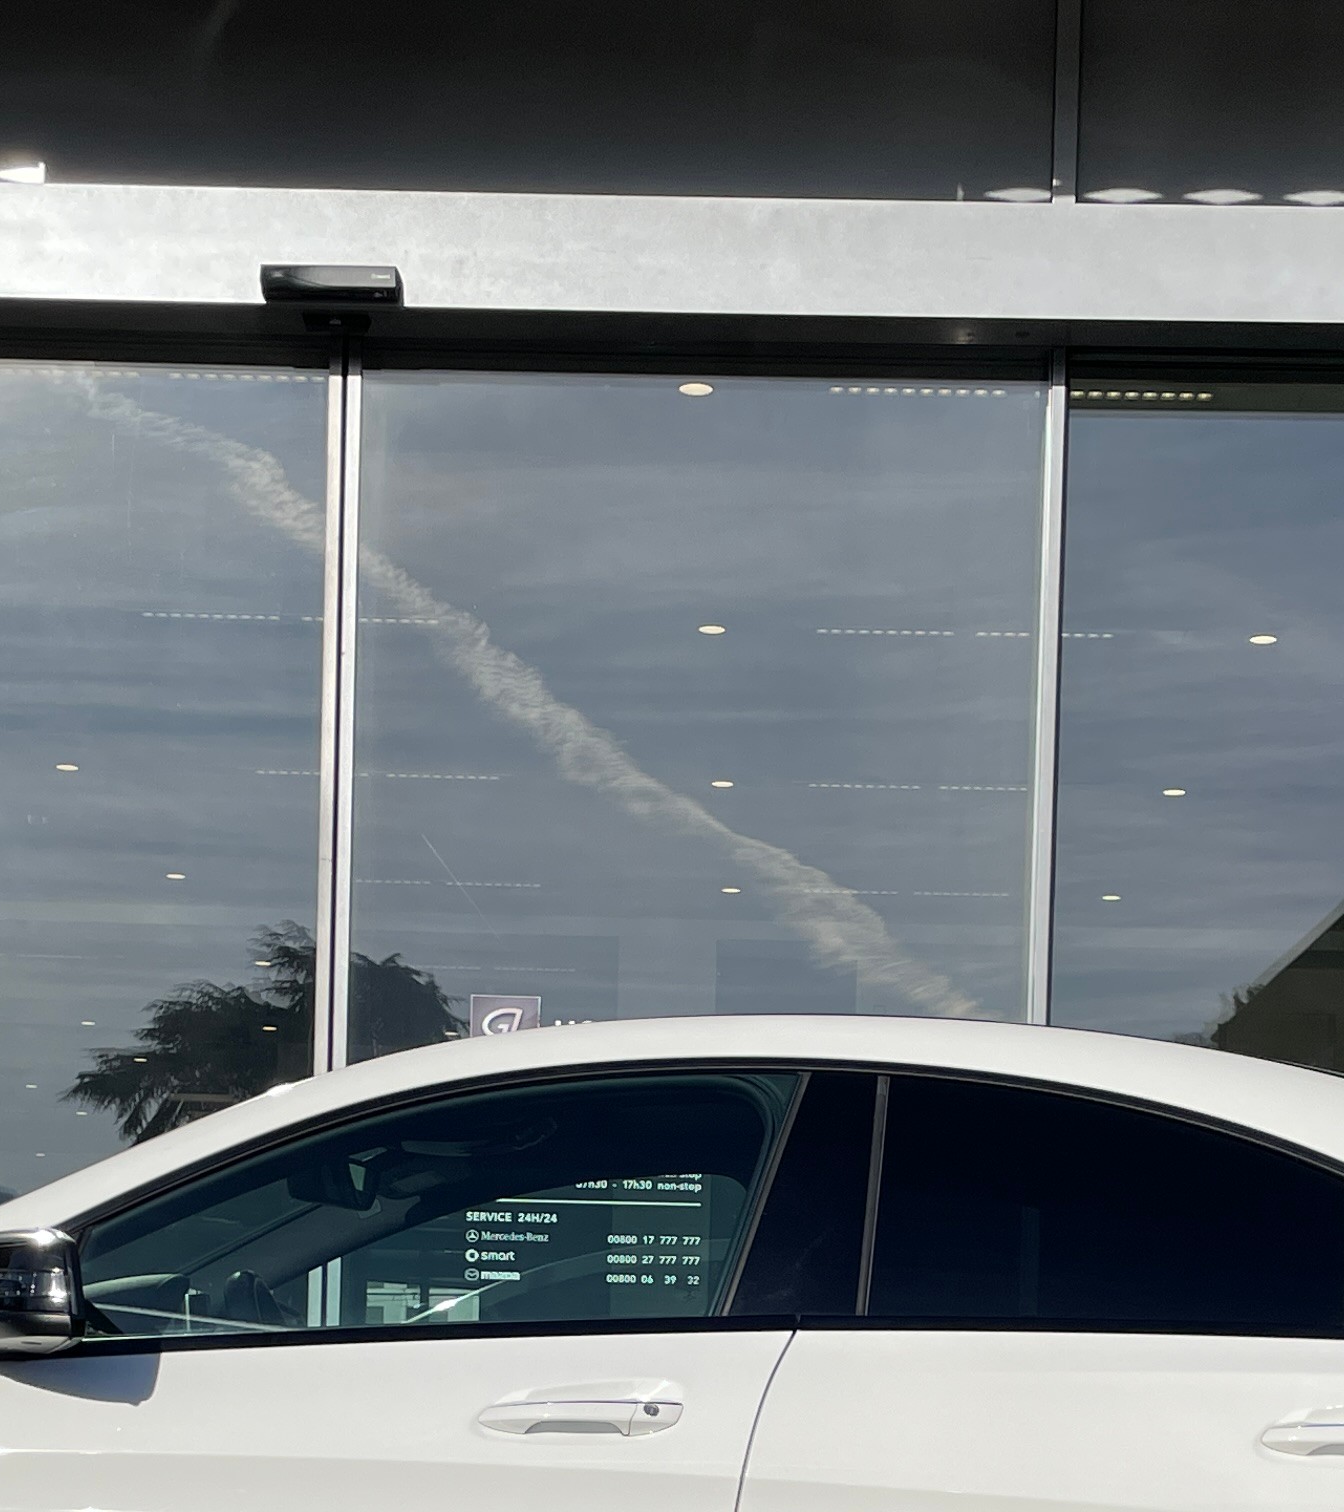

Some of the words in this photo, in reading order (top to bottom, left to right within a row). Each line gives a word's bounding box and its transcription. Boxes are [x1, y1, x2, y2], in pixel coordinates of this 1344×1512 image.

[622, 1180, 653, 1190] 17h30
[657, 1182, 702, 1193] non-stop
[465, 1211, 513, 1222] SERVICE
[517, 1212, 558, 1223] 24H/24
[480, 1230, 549, 1242] Mercedes-Benz
[607, 1235, 638, 1244] 00800
[642, 1235, 655, 1245] 17
[659, 1235, 678, 1245] 777
[682, 1236, 701, 1246] 777
[480, 1251, 516, 1261] smart
[606, 1254, 637, 1264] 00800
[641, 1255, 654, 1264] 27
[659, 1255, 677, 1265] 777
[682, 1256, 700, 1265] 777
[606, 1274, 637, 1283] 00800
[640, 1274, 654, 1284] 06
[664, 1275, 677, 1285] 39
[687, 1275, 700, 1285] 32
